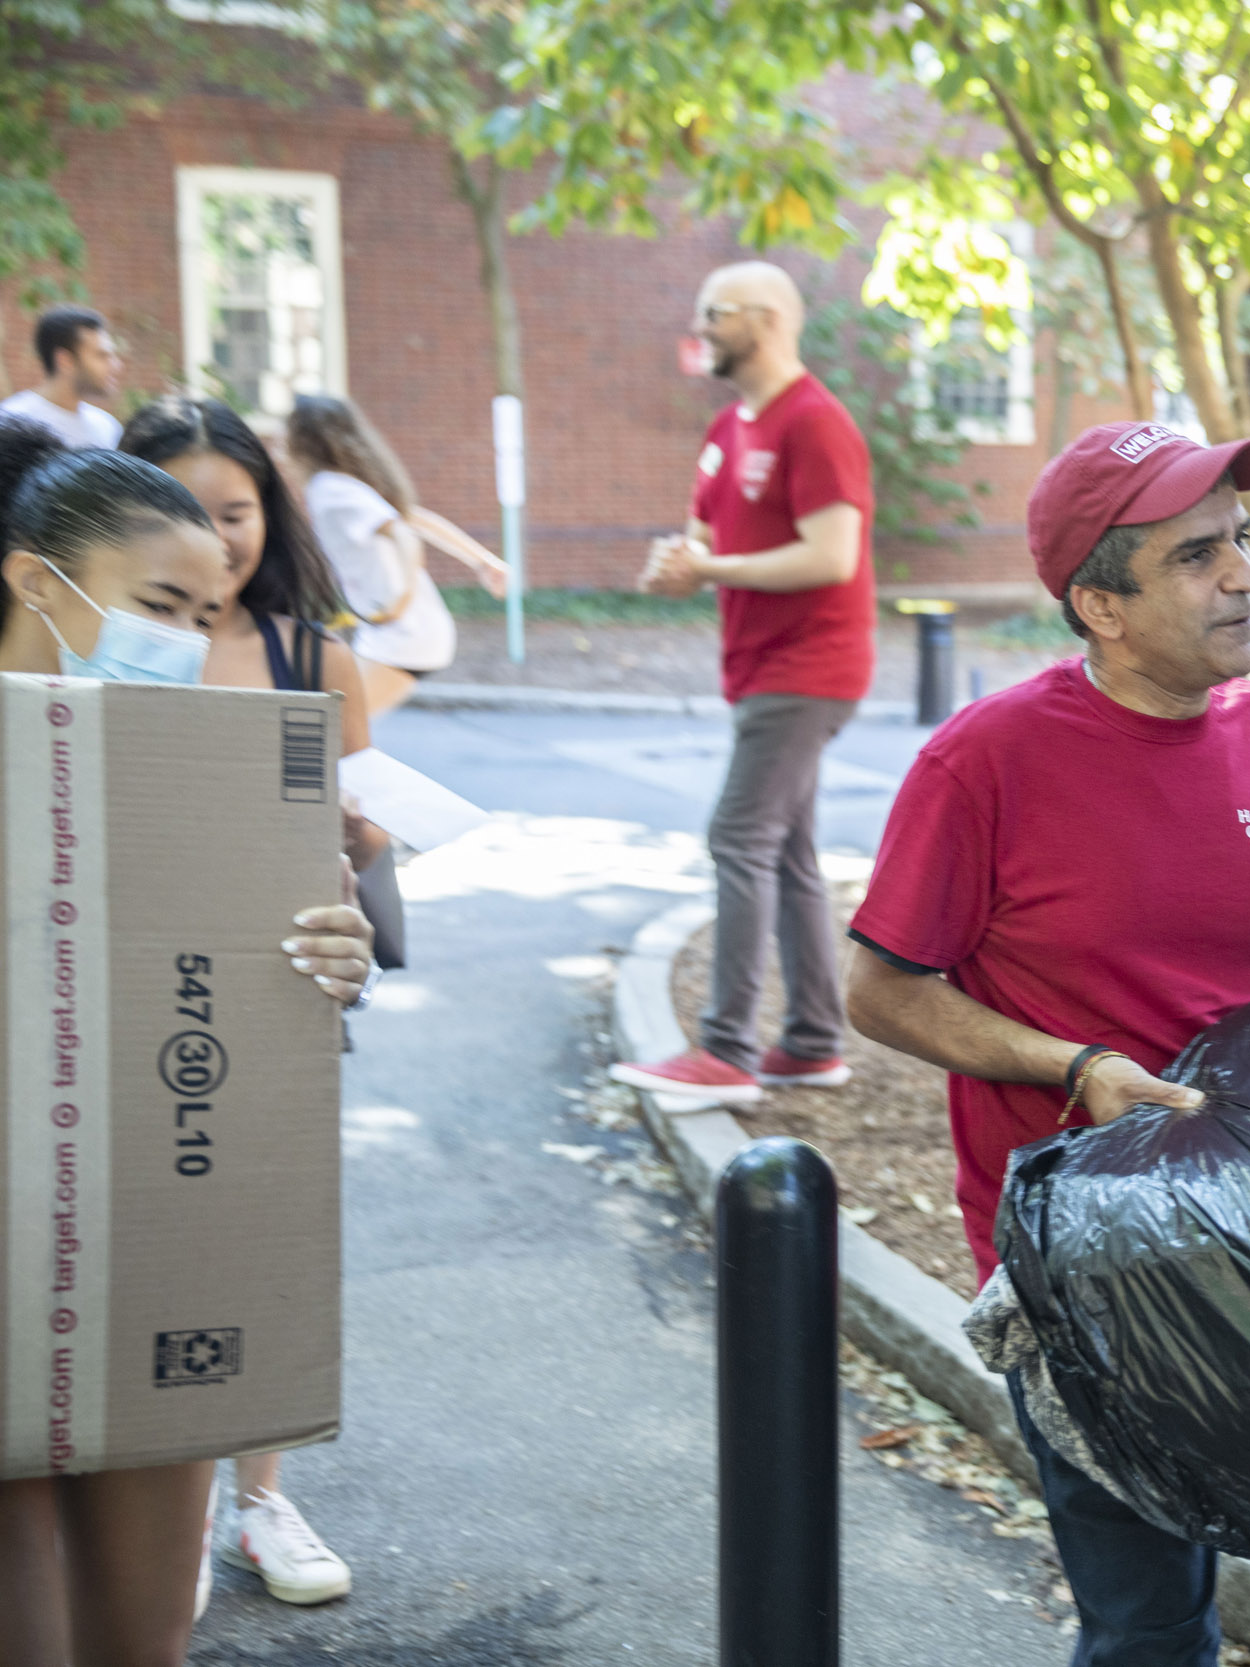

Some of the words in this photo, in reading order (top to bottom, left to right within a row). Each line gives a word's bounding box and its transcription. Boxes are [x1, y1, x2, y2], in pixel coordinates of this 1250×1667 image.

[49, 740, 79, 886] target.com
[50, 939, 82, 1087] target.com
[50, 1142, 82, 1293] target.com
[49, 1348, 76, 1472] rget.com
